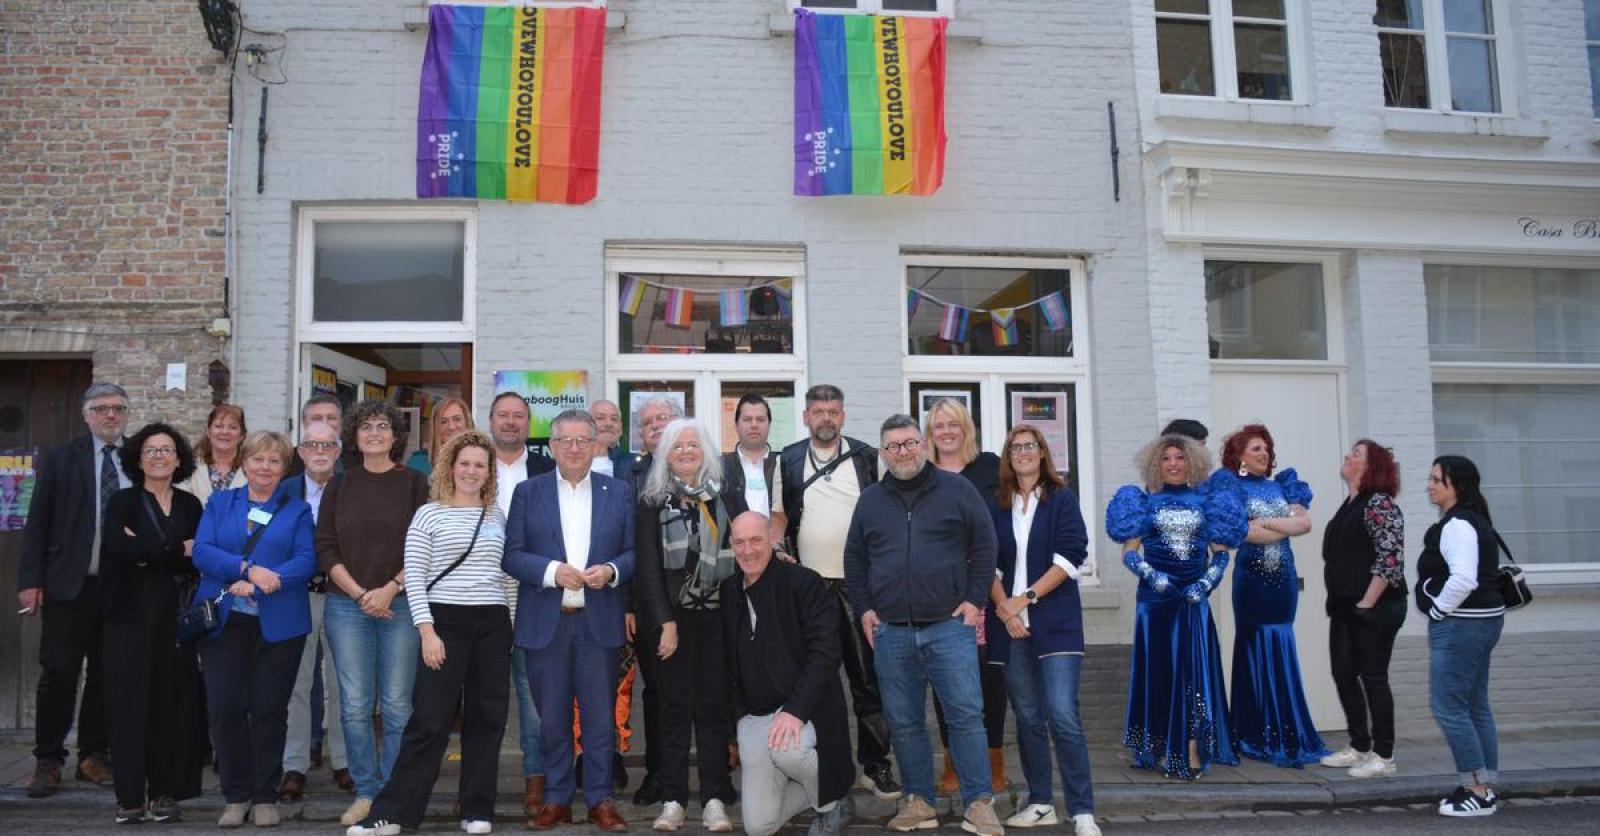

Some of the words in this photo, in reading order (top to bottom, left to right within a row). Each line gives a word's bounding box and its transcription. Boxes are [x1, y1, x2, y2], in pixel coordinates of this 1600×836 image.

[437, 133, 452, 177] PRIDE
[814, 131, 827, 174] PRIDE
[1518, 217, 1562, 237] Casa
[1572, 220, 1600, 238] B
